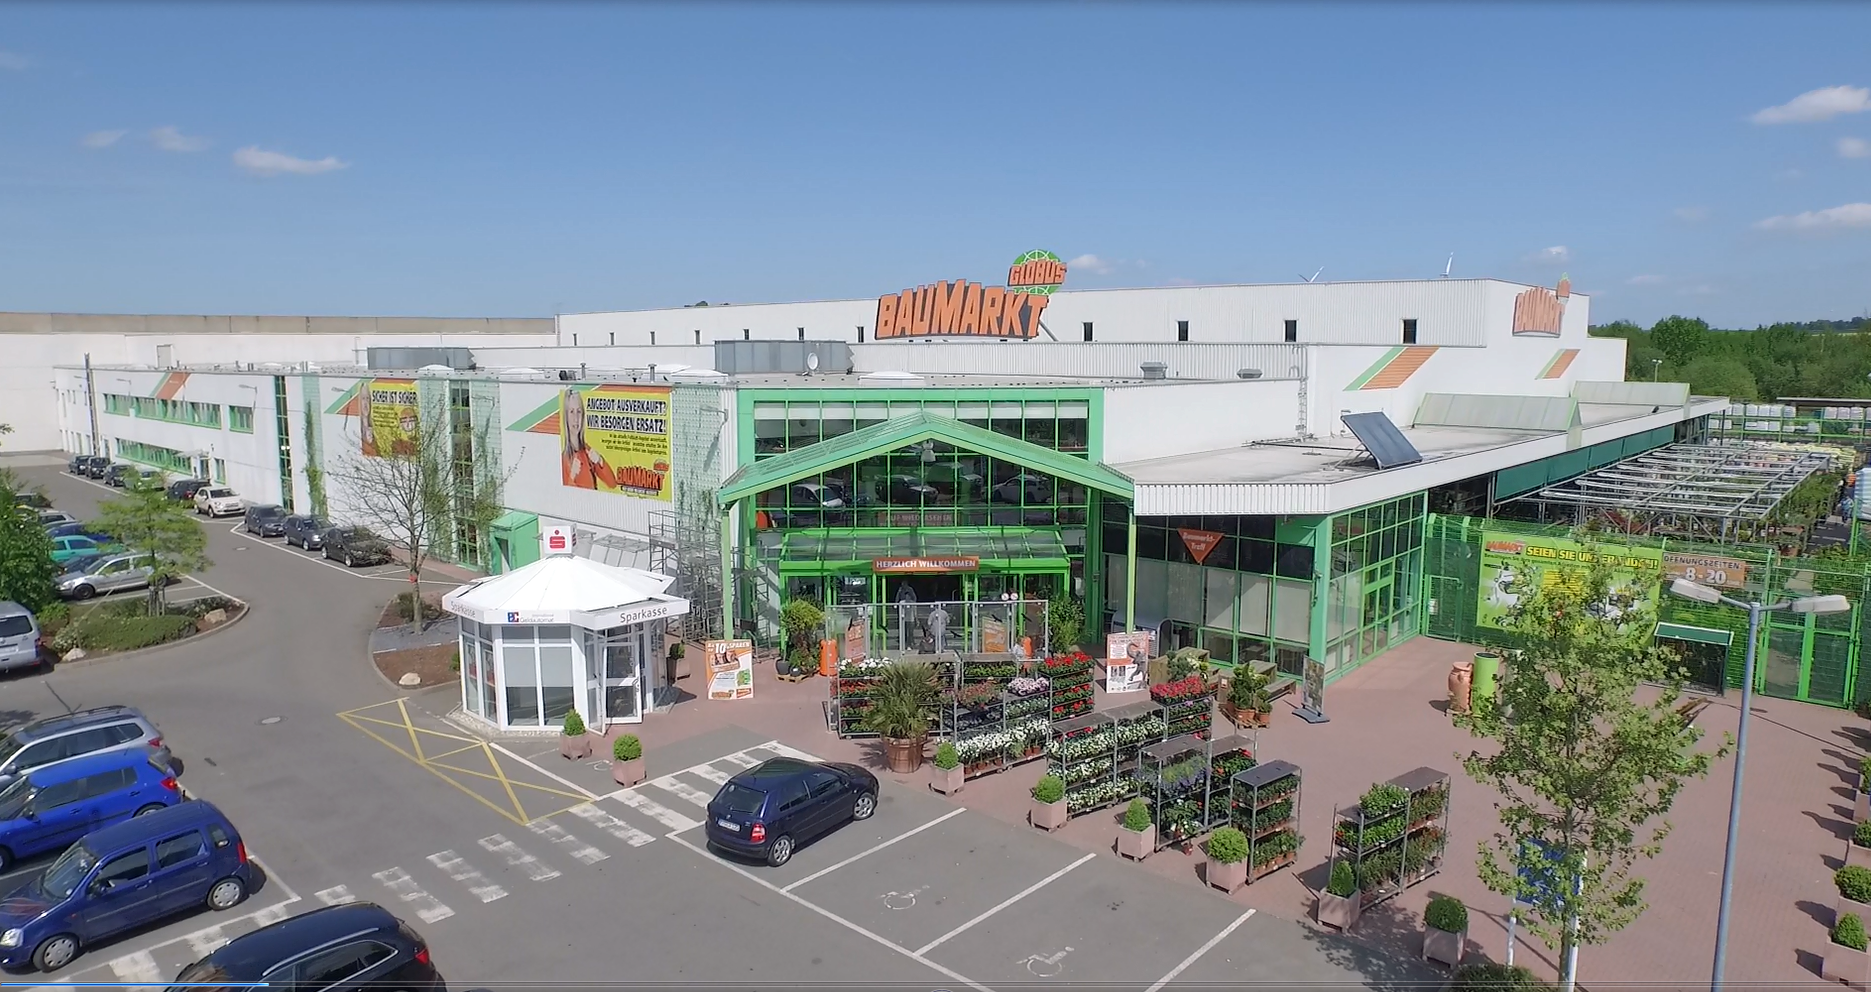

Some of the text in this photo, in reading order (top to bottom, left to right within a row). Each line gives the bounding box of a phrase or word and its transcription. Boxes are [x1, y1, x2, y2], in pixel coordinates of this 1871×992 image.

[1008, 259, 1067, 286] GLOBUS
[876, 279, 1048, 339] BAUMARKT
[586, 397, 667, 416] ANGEBOT AUSVERKAUFT?
[586, 414, 667, 434] WIR BESORGEN ERSATZ!
[616, 466, 664, 491] BAUMARKT
[1526, 546, 1556, 559] SEIEN
[1559, 550, 1575, 561] SIE
[876, 560, 976, 568] HERZLICH WILLKOMMEN
[1685, 567, 1696, 581] 8
[1705, 569, 1727, 585] 20
[450, 600, 476, 618] Sparkasse
[620, 607, 668, 624] Sparkasse
